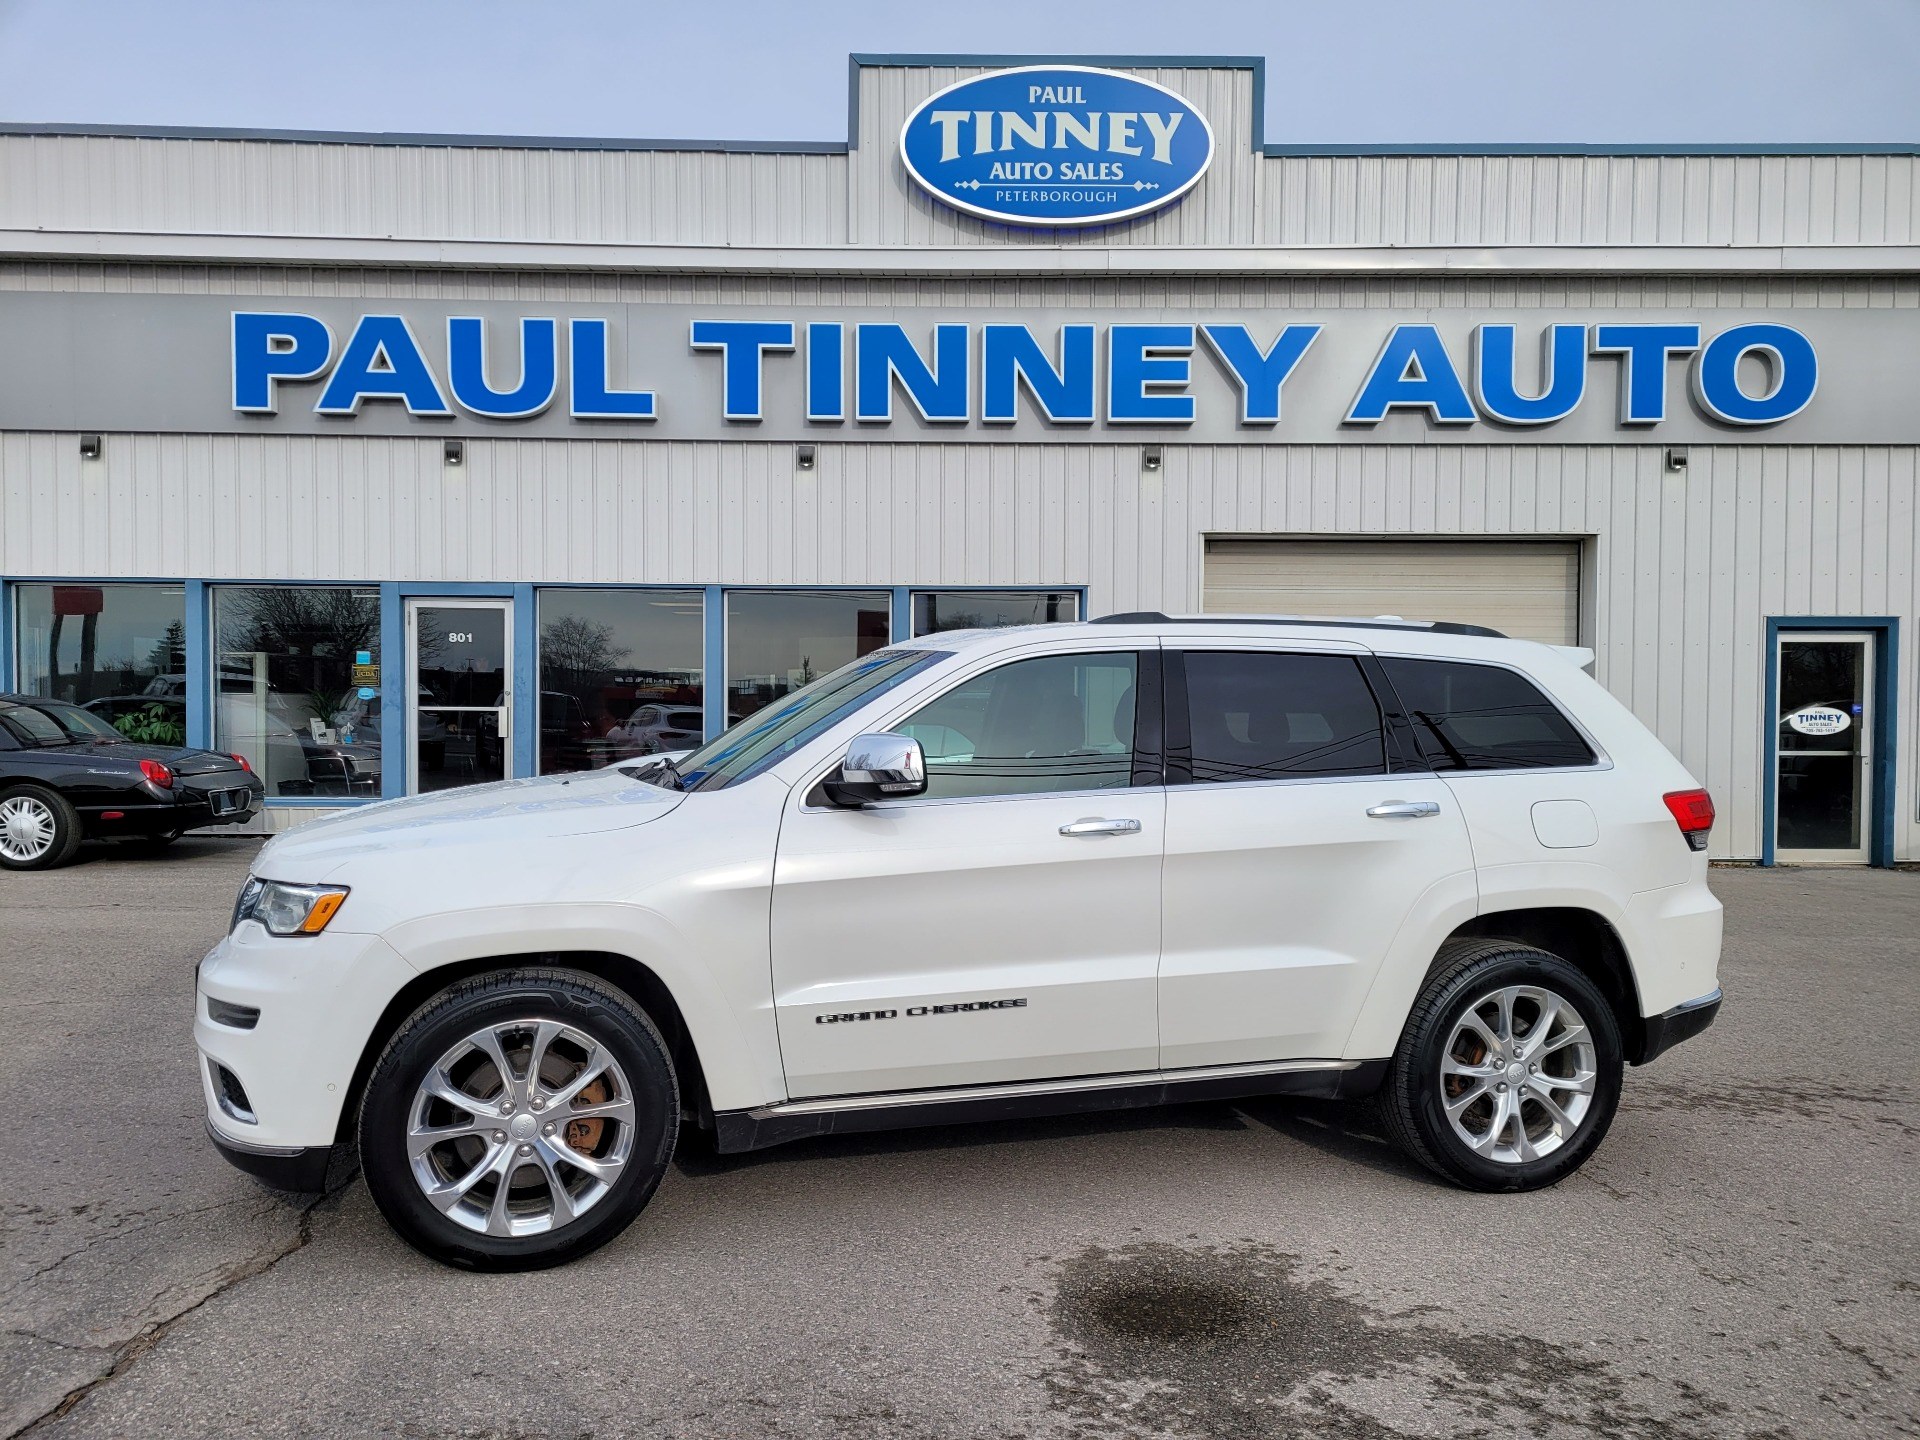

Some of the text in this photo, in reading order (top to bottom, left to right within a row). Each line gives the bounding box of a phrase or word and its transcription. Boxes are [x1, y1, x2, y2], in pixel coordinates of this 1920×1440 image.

[1029, 86, 1086, 104] PAUL
[930, 110, 1184, 165] TINNEY
[989, 162, 1124, 180] AUTO SALES
[996, 191, 1117, 203] PETERBOROUGH
[231, 311, 1819, 425] PAUL TINNEY AUTO
[448, 632, 473, 643] 801
[1797, 714, 1842, 724] TINNEY
[815, 998, 1028, 1024] GRAND CHEROKEE
